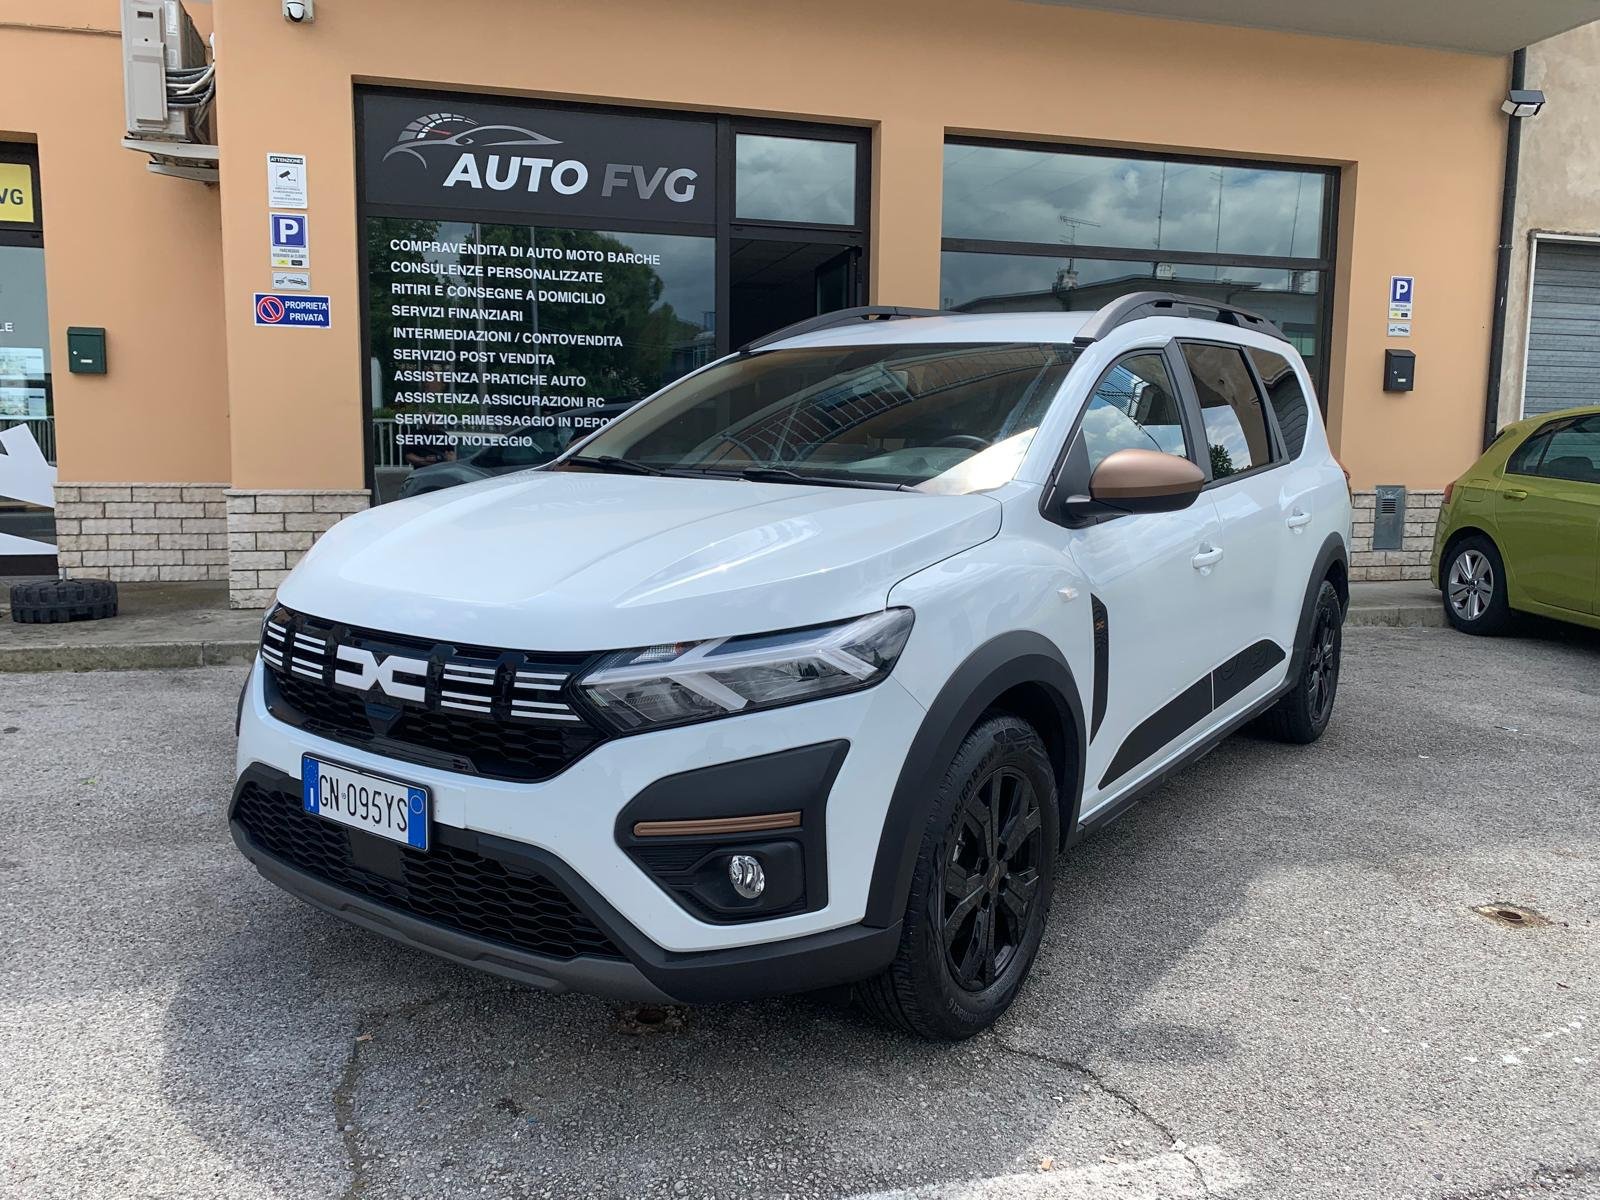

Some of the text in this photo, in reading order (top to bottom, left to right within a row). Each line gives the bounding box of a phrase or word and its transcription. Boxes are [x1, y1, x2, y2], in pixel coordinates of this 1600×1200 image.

[443, 153, 698, 202] AUTO FVG
[279, 218, 299, 243] P
[390, 239, 660, 265] COMPRAVENDITA DI AUTO MOTO BARCHE
[391, 261, 603, 283] CONSULENZE PERSONALIZZATE
[392, 283, 605, 305] RITIRI E CONSEGNE A DOMICILIO
[1396, 280, 1408, 299] P
[290, 312, 324, 321] PRIVATA
[391, 305, 523, 322] SERVIZI FINANZIARI
[394, 327, 511, 342] INTERMEDIAZIONI
[522, 333, 623, 347] CONTOVENDITA
[393, 349, 555, 365] SERVIZIO POST VENDITA
[394, 370, 586, 387] ASSISTENZA PRATICHE AUTO
[395, 392, 605, 408] ASSISTENZA ASSICURAZIONI RC
[395, 413, 617, 428] SERVIZIO RIMESSAGGIO IN DEPO
[396, 434, 532, 447] SERVIZIO NOLEGGIO
[320, 775, 407, 832] GN 095YS
